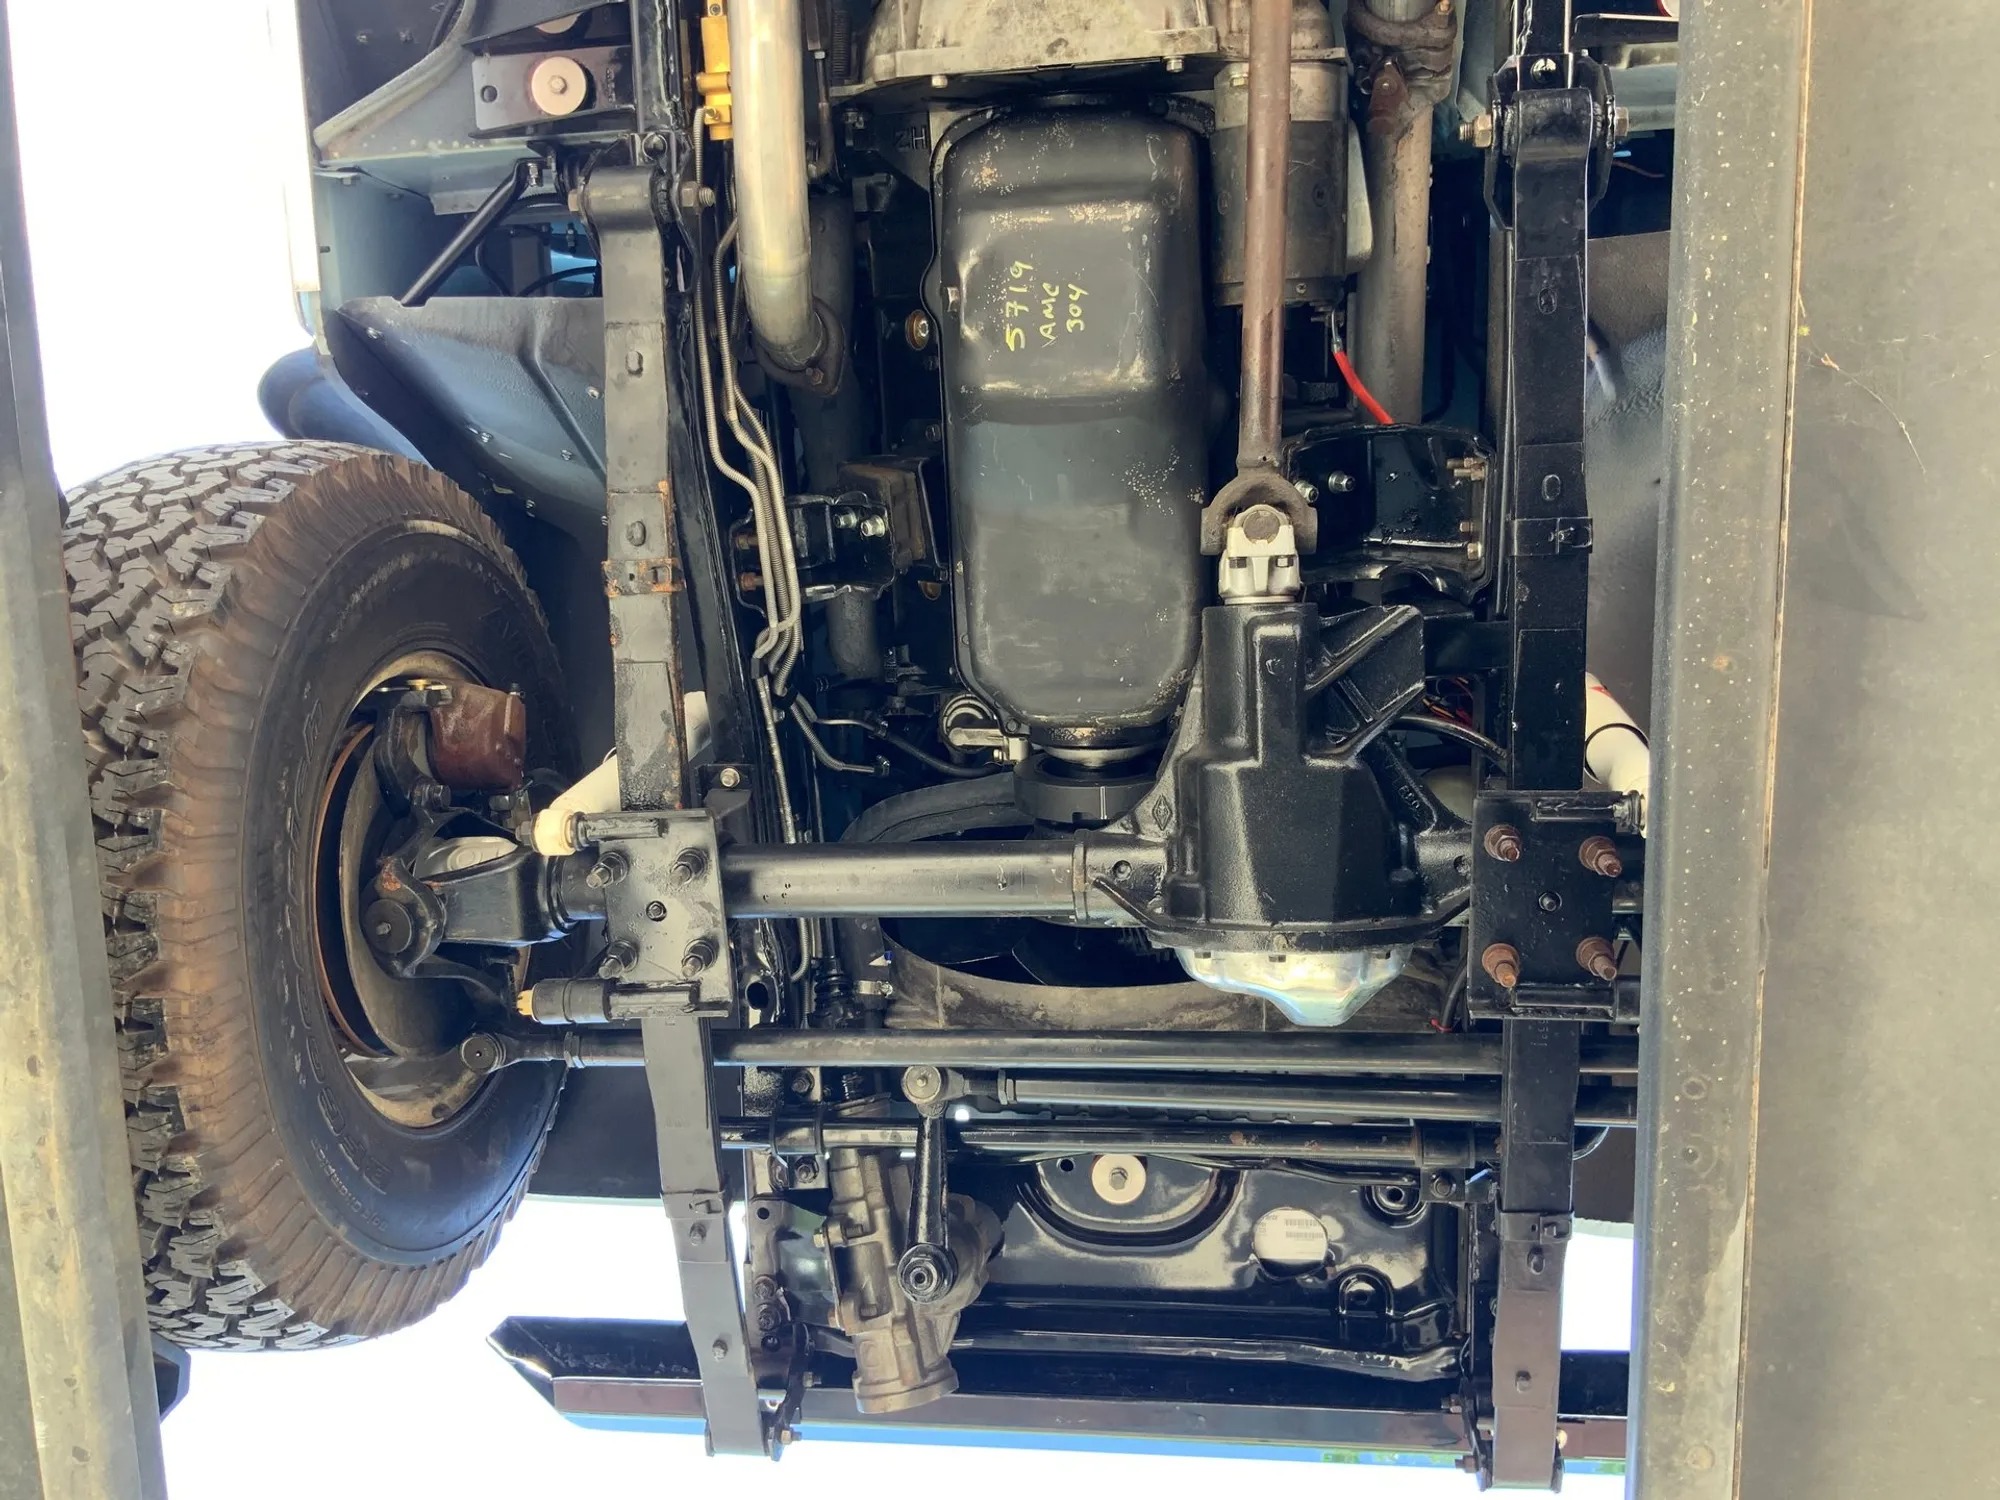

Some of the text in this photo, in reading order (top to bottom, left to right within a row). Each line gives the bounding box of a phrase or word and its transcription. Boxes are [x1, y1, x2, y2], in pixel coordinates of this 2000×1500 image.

[1005, 260, 1033, 351] 5719
[1040, 282, 1060, 341] AMC
[1066, 283, 1089, 333] 304
